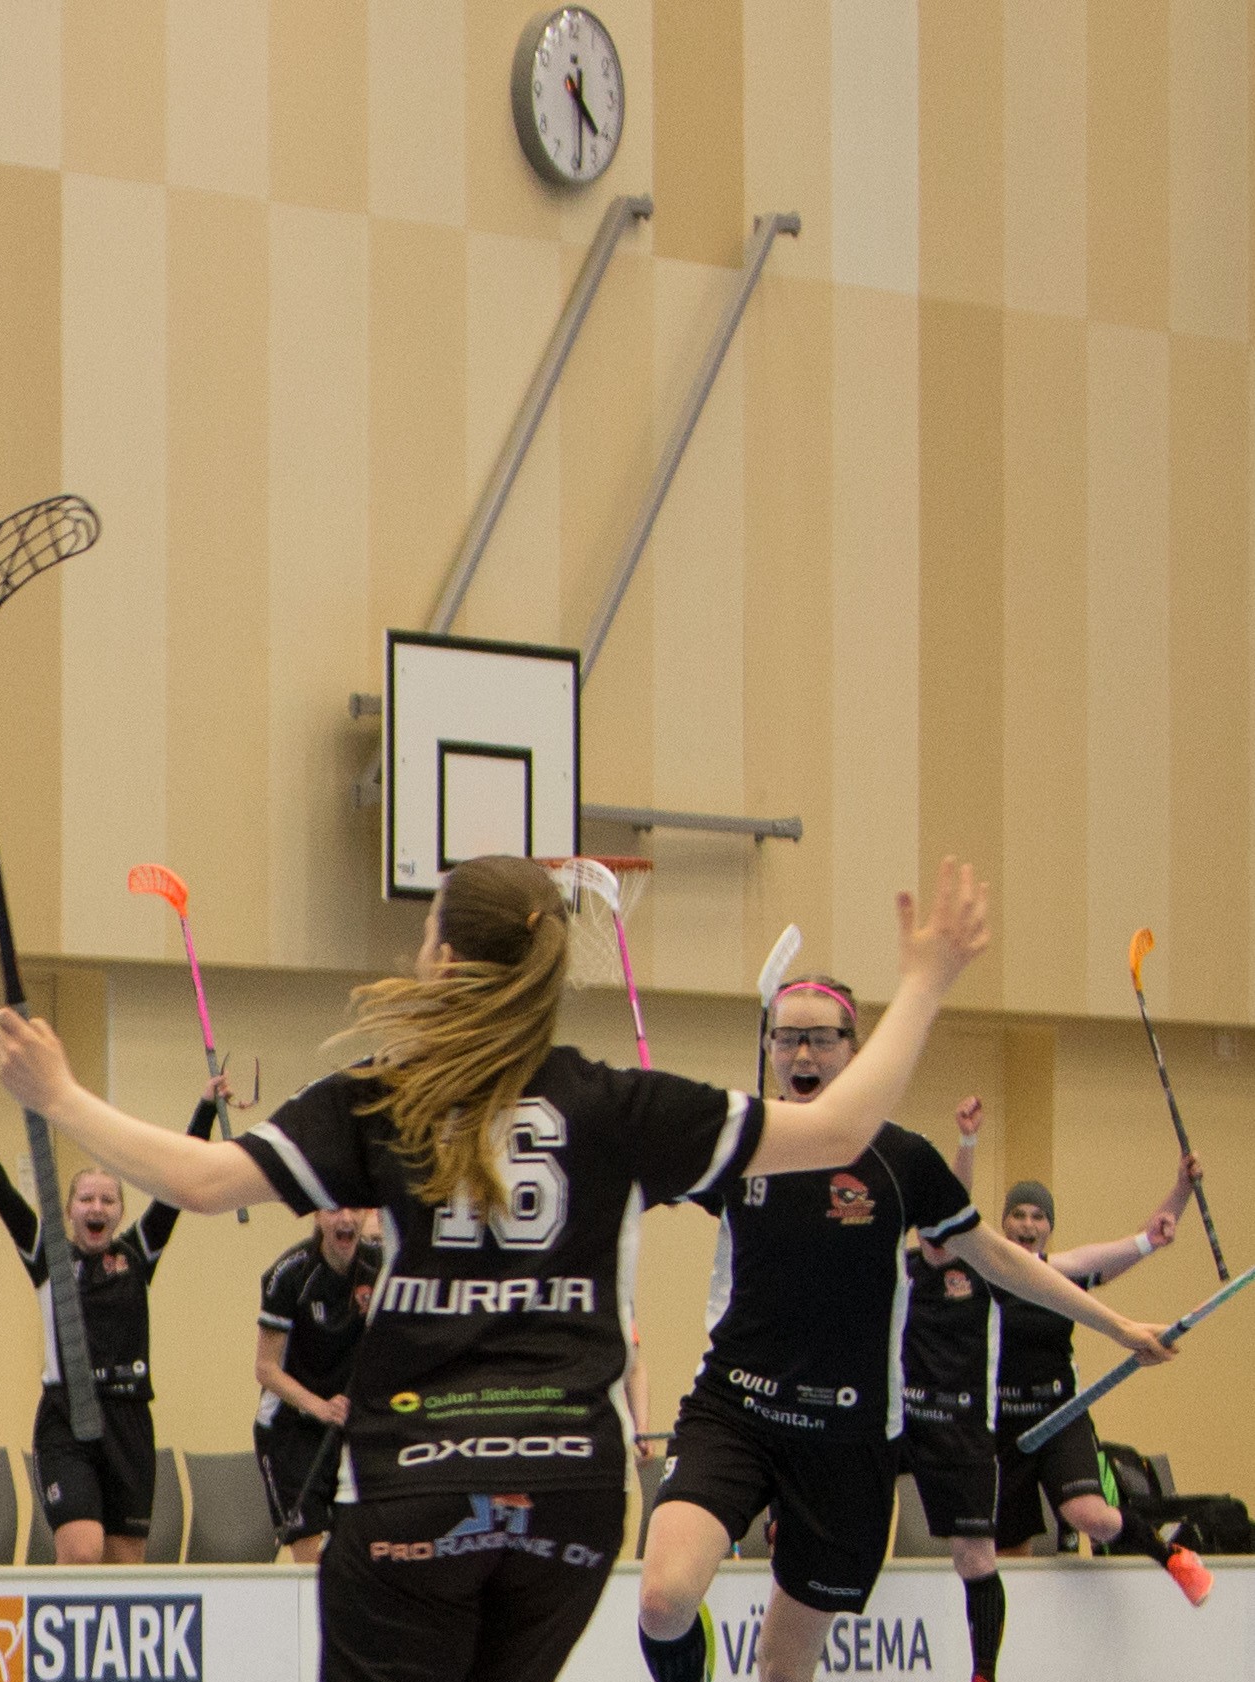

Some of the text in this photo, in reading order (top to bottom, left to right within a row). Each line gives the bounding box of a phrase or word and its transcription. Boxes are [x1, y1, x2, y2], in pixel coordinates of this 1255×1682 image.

[743, 1177, 768, 1206] 19
[382, 1276, 594, 1314] MURAJA
[728, 1368, 778, 1398] OULU
[398, 1435, 593, 1468] OXDOG
[32, 1603, 198, 1682] STARK
